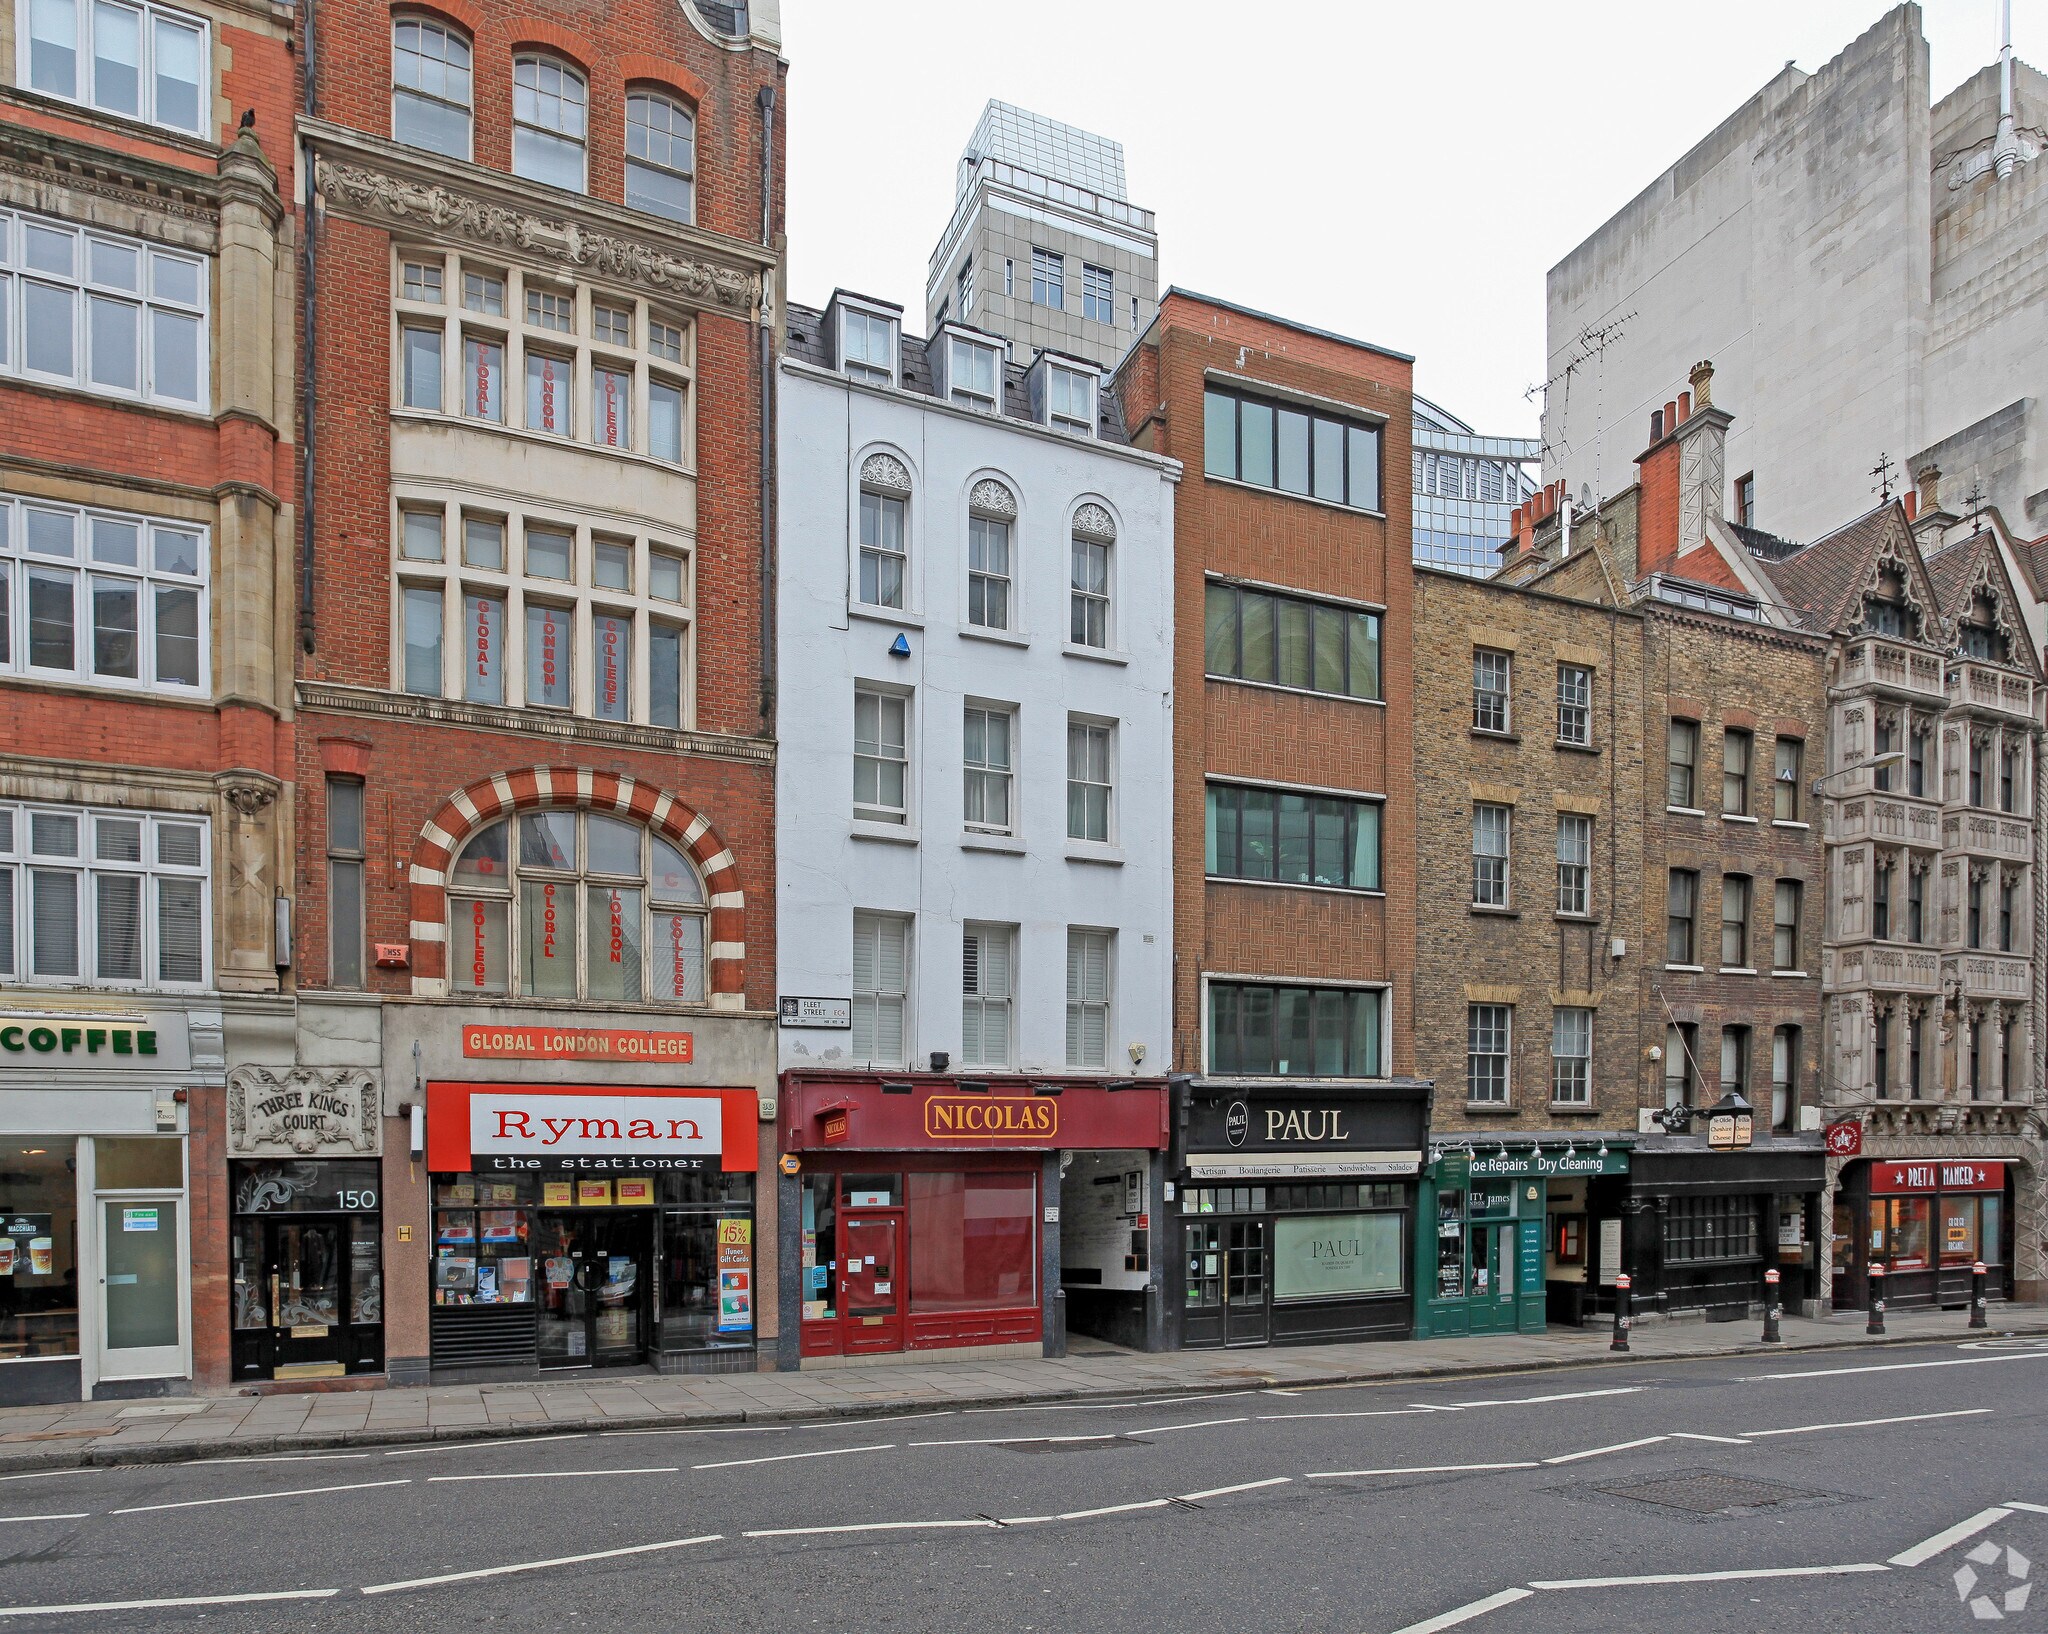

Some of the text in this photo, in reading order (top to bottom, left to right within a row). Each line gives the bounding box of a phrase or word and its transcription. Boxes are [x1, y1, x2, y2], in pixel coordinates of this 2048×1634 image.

[476, 343, 490, 414] GLOBAL
[604, 371, 617, 447] COLLEGE
[476, 600, 490, 677] GLOBAL
[605, 619, 617, 704] COLLEGE
[543, 883, 556, 958] GLOBAL
[609, 888, 623, 963] LONDON
[473, 901, 486, 987] COLLEGE
[672, 915, 685, 998] COLLEGE
[0, 1026, 158, 1055] COFFEE
[470, 1033, 688, 1056] GLOBAL LONDON COLLEGE
[257, 1092, 350, 1118] THREE KINGS
[282, 1114, 327, 1130] COURT
[492, 1110, 704, 1146] Ryman
[826, 1121, 846, 1134] NICOLAS
[933, 1105, 1050, 1130] NICOLAS
[1228, 1114, 1247, 1127] PAUL
[1264, 1109, 1350, 1141] PAUL
[493, 1156, 704, 1169] the stationer
[1199, 1163, 1413, 1176] Artisan Boulangerie Patisserie Sandwiches Salades
[1488, 1158, 1529, 1174] Repairs
[1538, 1158, 1558, 1174] Dry
[1559, 1156, 1603, 1173] Cleaning
[1907, 1166, 1974, 1187] PRET A MANGER
[336, 1190, 376, 1209] 150
[1469, 1193, 1484, 1201] ITY
[399, 1227, 411, 1240] H
[723, 1226, 747, 1243] 15%
[720, 1255, 749, 1263] Gift Cards
[725, 1247, 744, 1255] iTunes
[1311, 1239, 1366, 1258] PAUL
